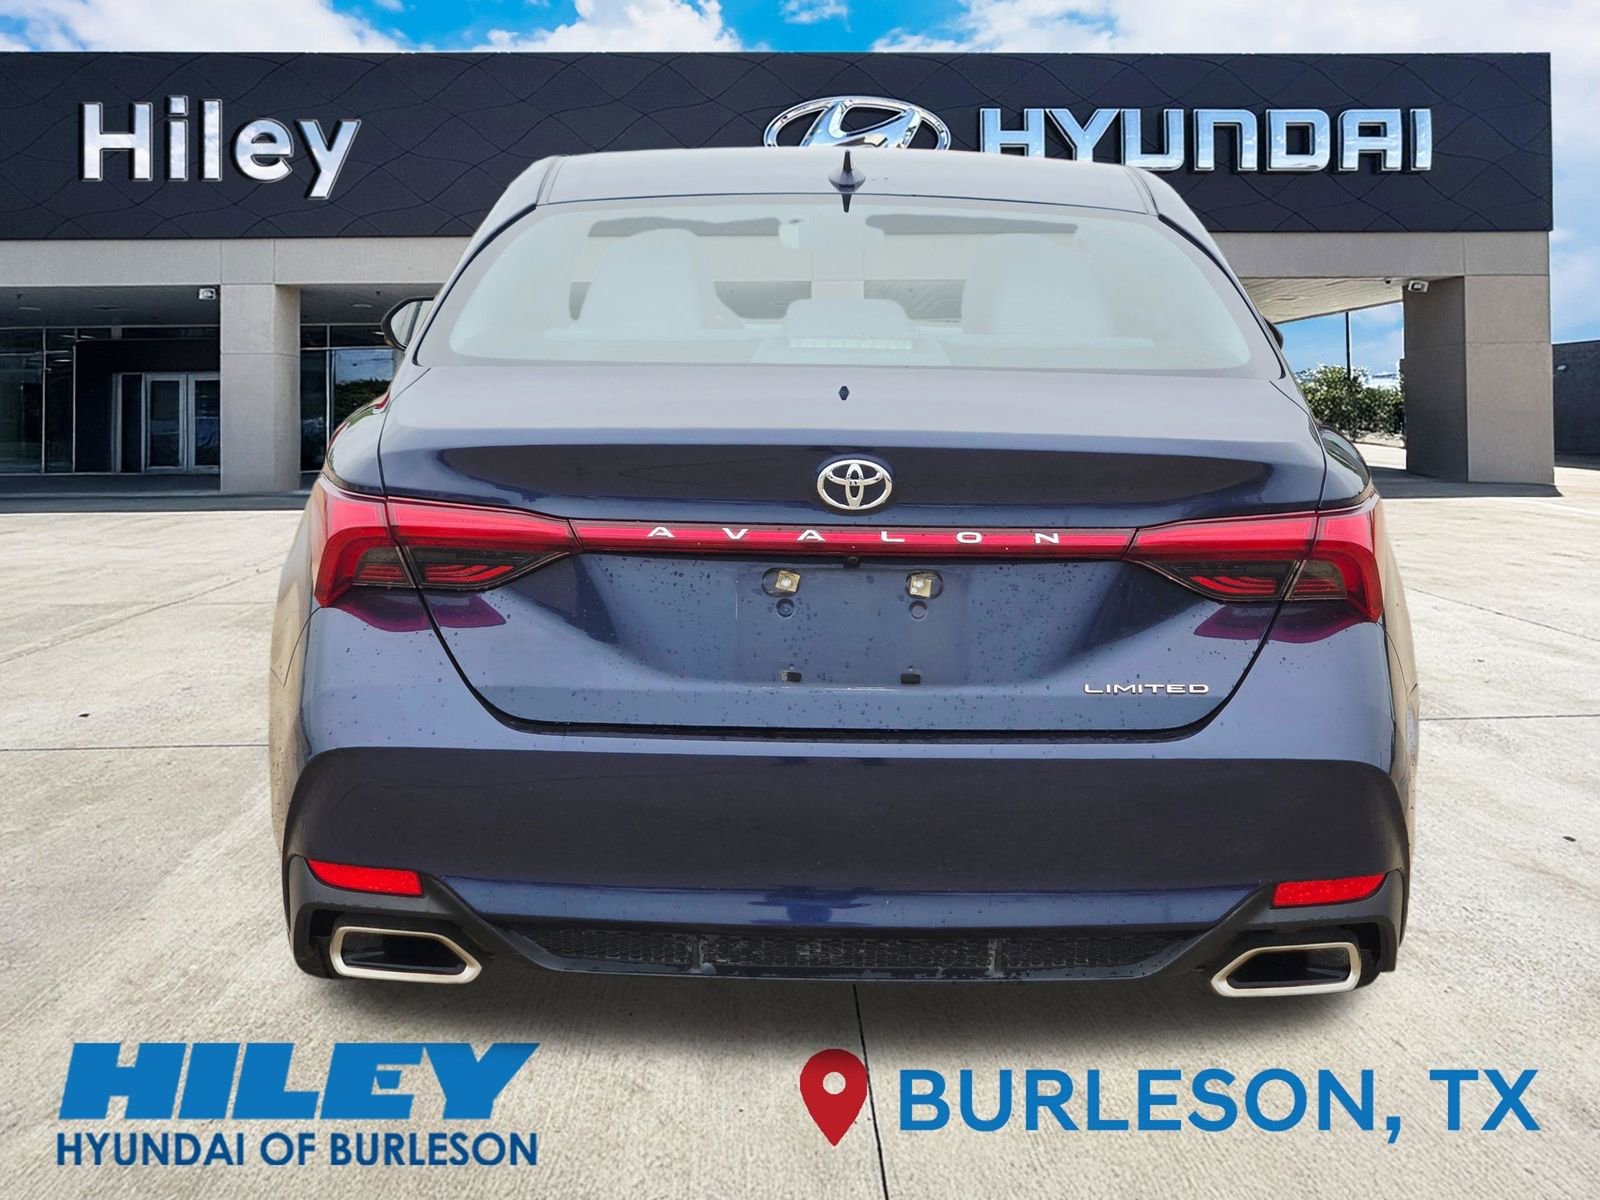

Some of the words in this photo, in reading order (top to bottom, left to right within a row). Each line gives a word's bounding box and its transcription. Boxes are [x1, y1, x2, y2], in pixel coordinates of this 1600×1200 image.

[80, 95, 361, 199] Hiley
[979, 108, 1433, 172] HYUNDAI
[647, 525, 1060, 545] AVALON
[1084, 683, 1210, 695] LIMITED
